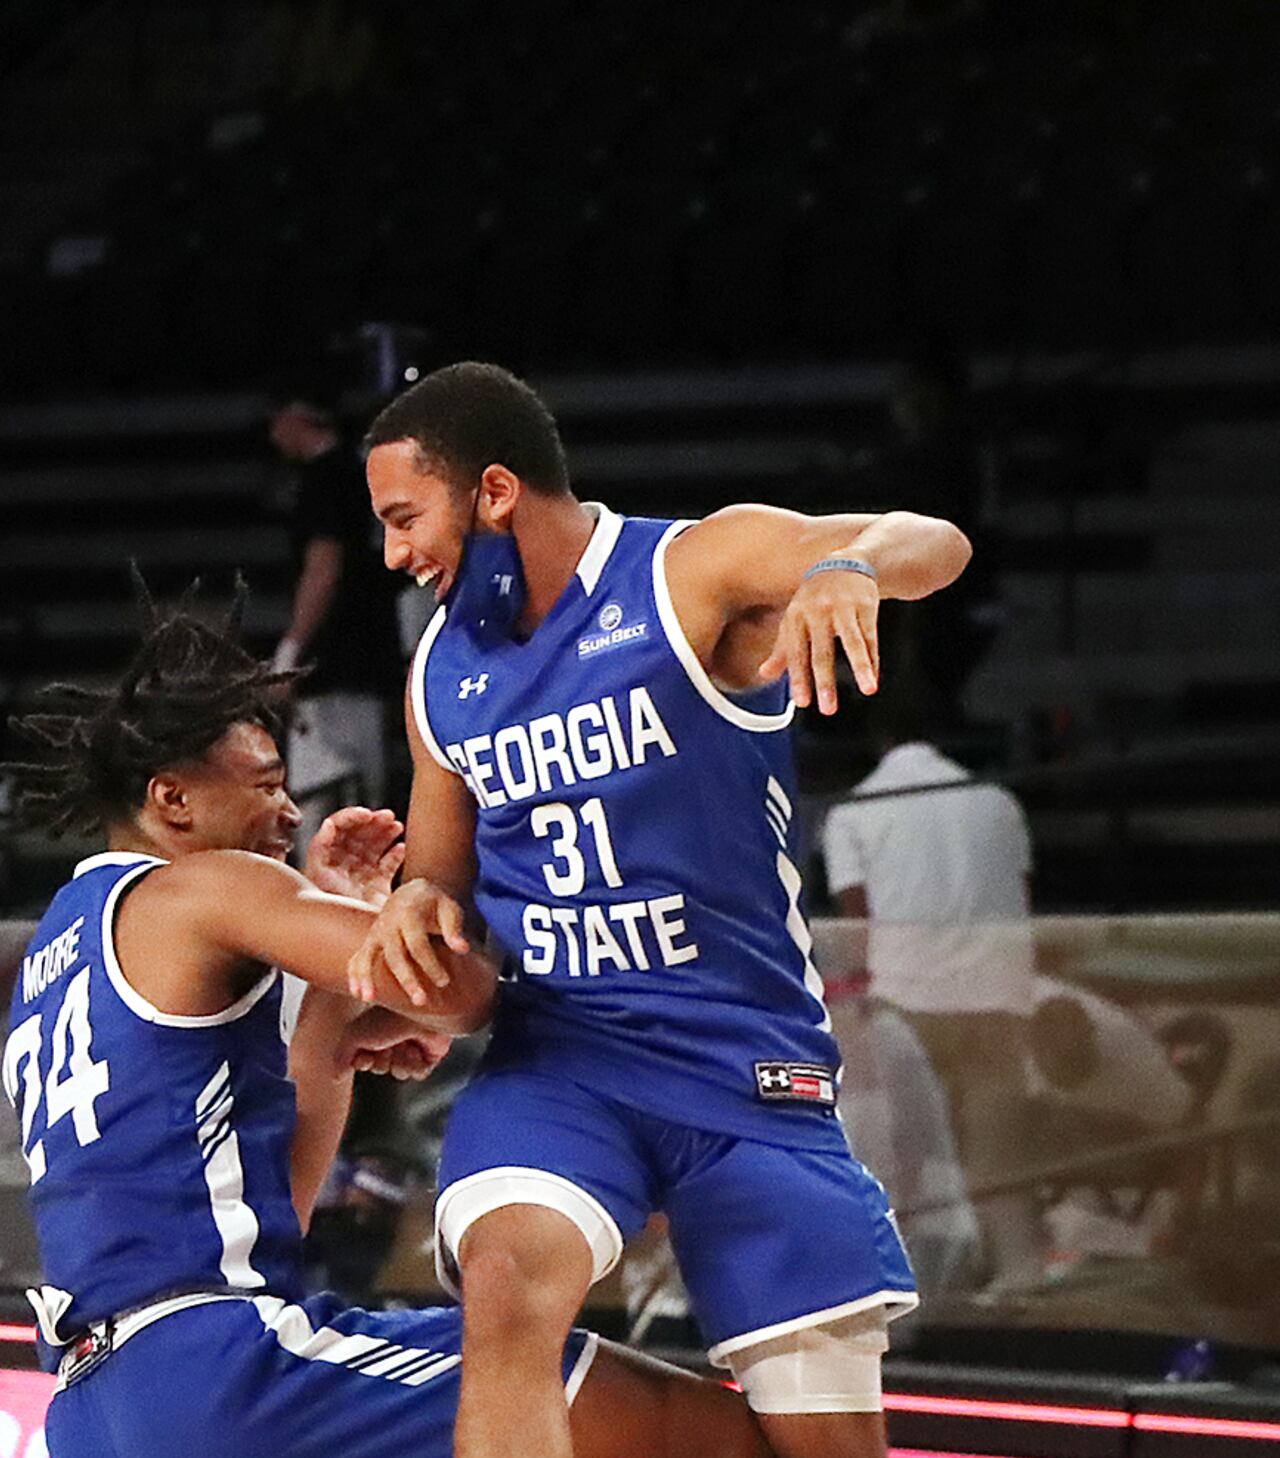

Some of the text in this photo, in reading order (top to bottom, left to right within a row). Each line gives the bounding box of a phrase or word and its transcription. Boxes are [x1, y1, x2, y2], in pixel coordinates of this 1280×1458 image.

[530, 798, 624, 898] 31
[22, 916, 85, 1003] MOORE
[522, 894, 699, 977] STATE
[2, 965, 109, 1186] 24
